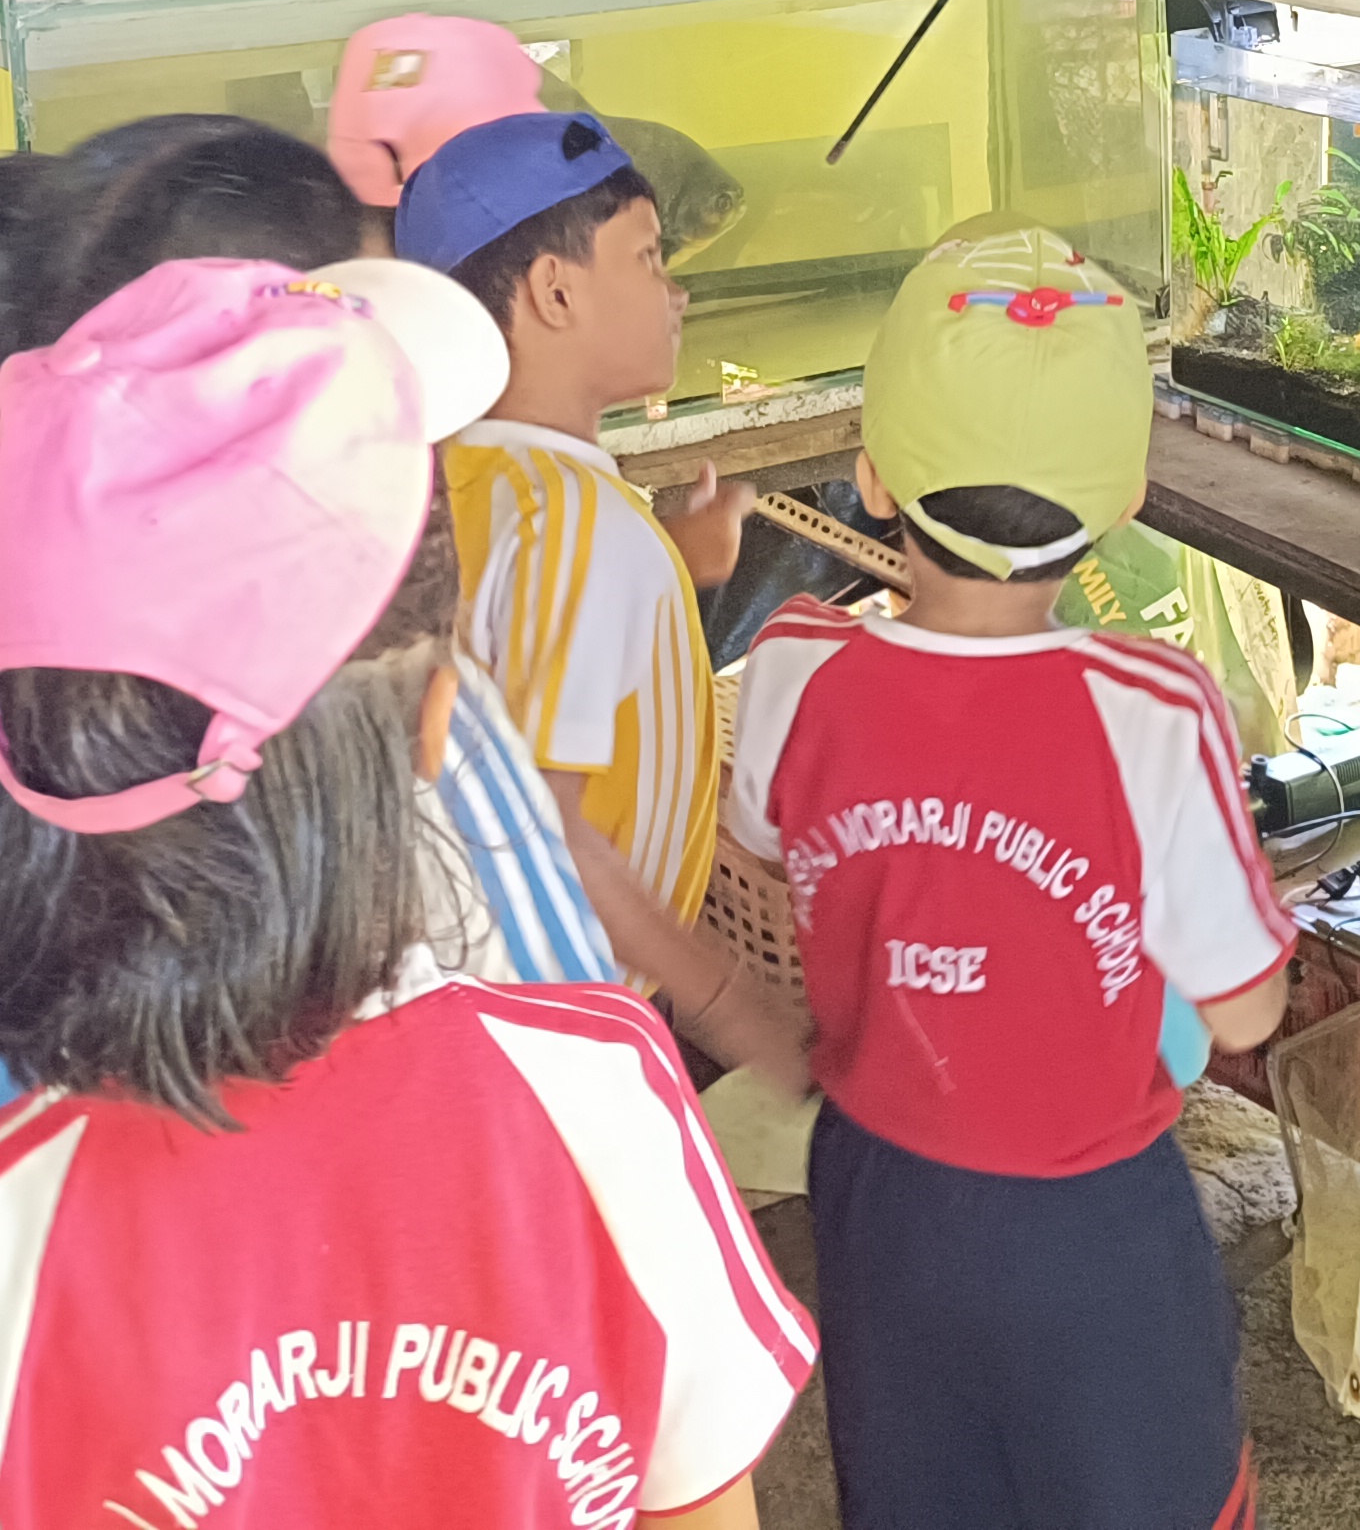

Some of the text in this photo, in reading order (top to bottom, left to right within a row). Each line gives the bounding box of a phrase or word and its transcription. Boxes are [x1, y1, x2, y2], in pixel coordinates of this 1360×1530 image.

[884, 939, 987, 994] ICSE
[974, 810, 1090, 899] PUBLIC
[1074, 884, 1142, 1007] SCHOOL
[135, 1321, 370, 1530] MORARJI
[381, 1323, 570, 1445] PUBLIC
